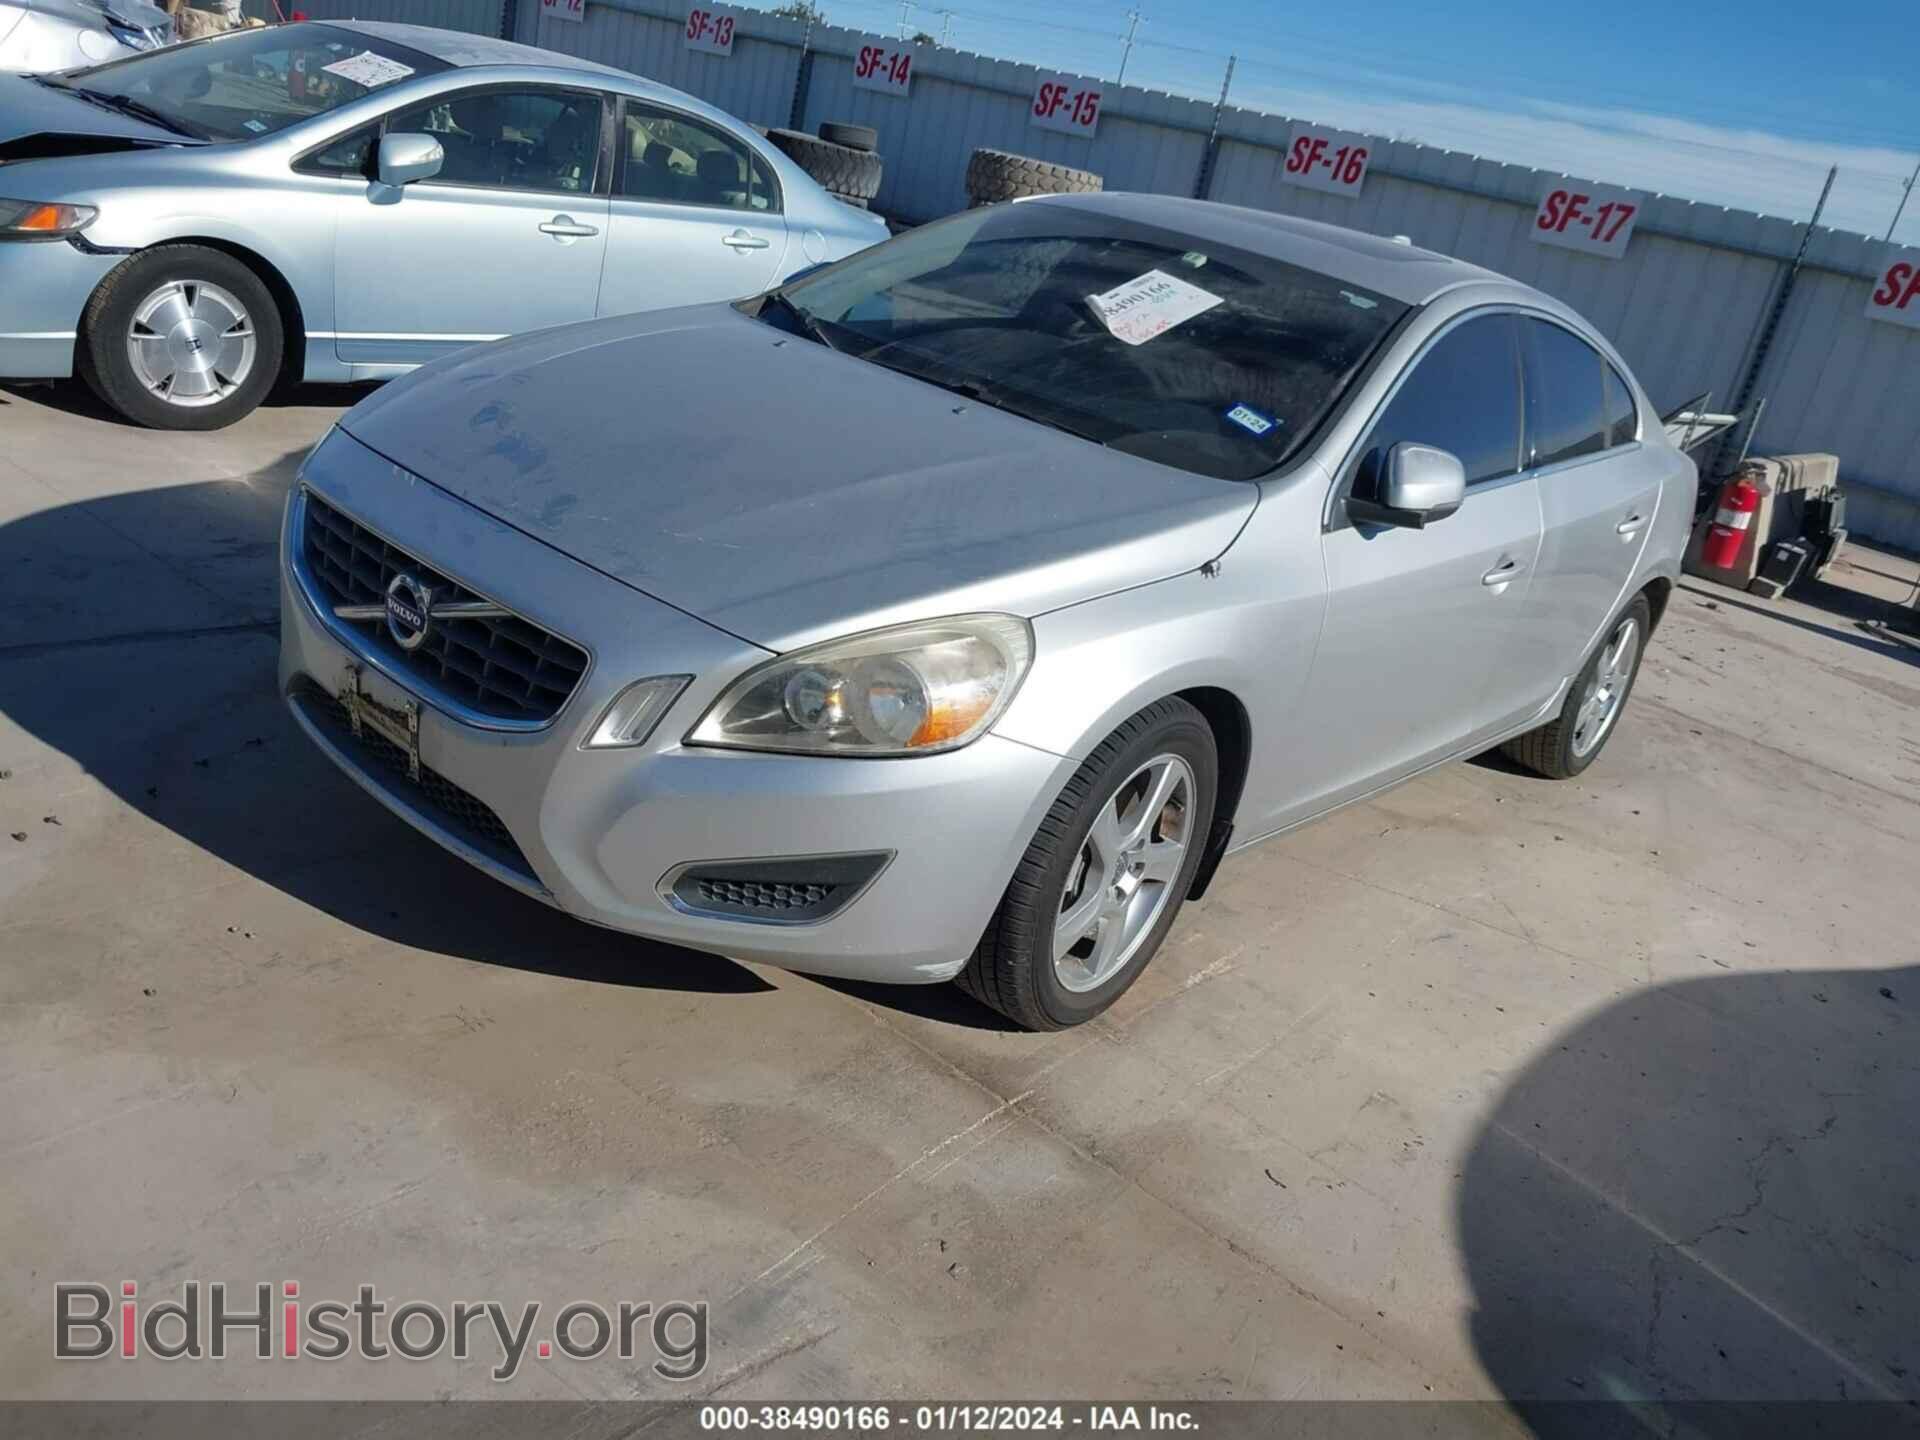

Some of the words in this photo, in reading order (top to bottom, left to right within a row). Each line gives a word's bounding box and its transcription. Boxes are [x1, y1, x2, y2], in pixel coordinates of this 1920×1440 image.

[687, 9, 734, 47] SF-13
[856, 46, 912, 85] SF-14
[1034, 82, 1100, 126] SF-15
[1287, 136, 1368, 184] SF-16
[1537, 190, 1635, 243] SF-17
[1104, 282, 1171, 317] 8490166
[387, 598, 421, 627] VOLVO
